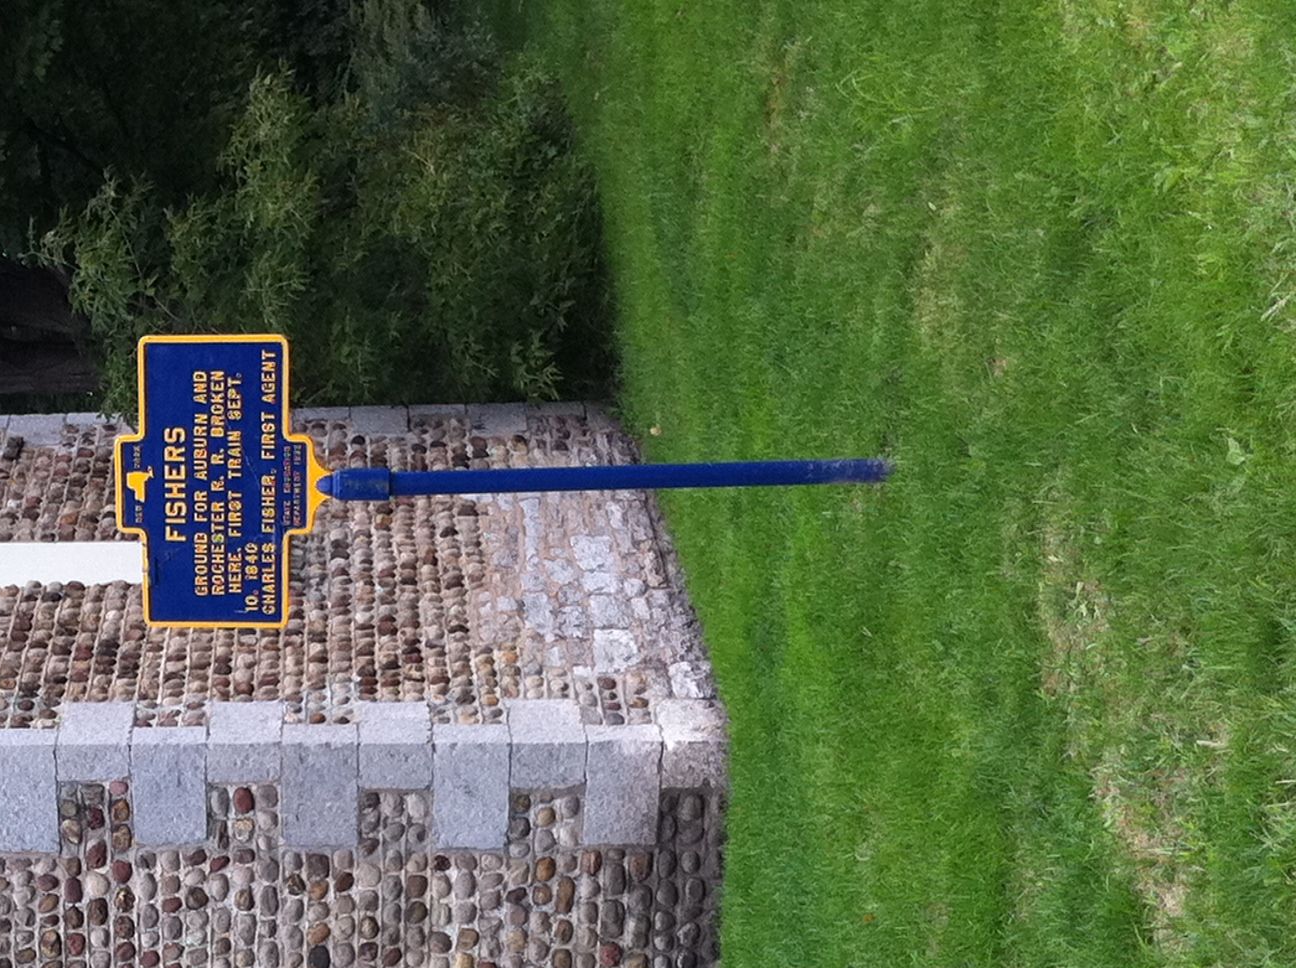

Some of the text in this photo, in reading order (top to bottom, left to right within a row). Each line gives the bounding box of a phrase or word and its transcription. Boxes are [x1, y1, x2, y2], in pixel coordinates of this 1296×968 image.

[228, 372, 242, 420] SEPT.
[262, 349, 276, 403] AGENT
[228, 431, 242, 479] TRAIN
[262, 412, 276, 460] FIRST
[164, 427, 186, 542] FISHERS
[194, 371, 208, 596] GROUND FOR AUBURN AND
[211, 371, 224, 595] ROCHESTER R. R. BROKEN
[228, 491, 242, 536] FIRST
[245, 543, 258, 580] 1840
[262, 543, 276, 614] CHARLES
